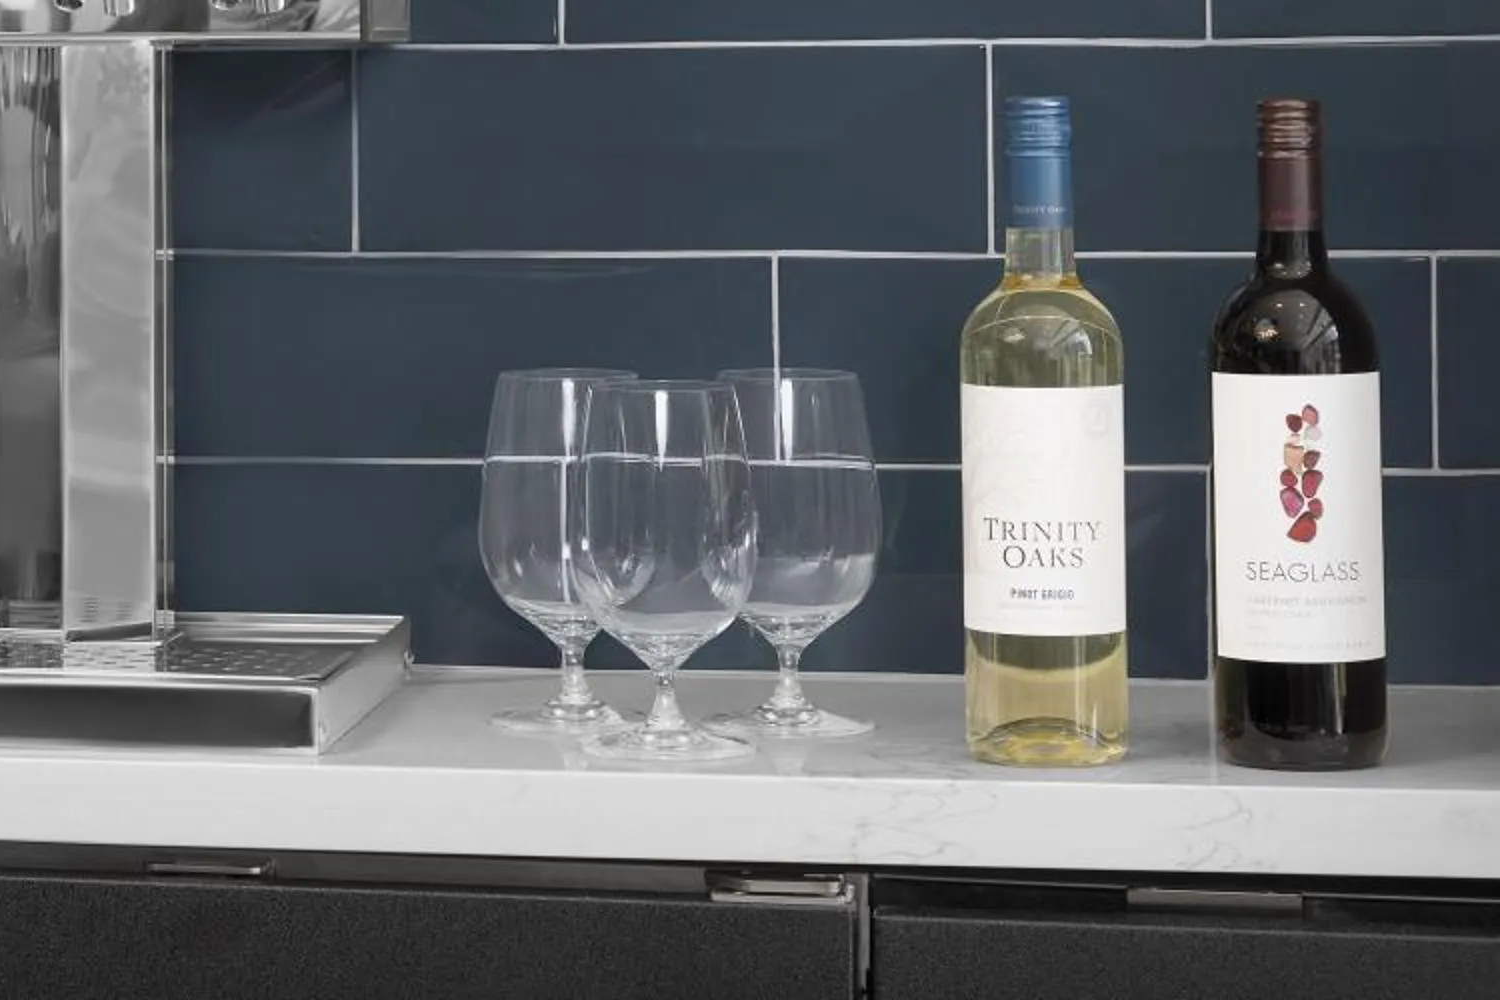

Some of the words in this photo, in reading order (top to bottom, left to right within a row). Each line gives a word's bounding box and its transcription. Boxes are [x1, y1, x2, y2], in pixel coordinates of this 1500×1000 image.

[983, 517, 1102, 542] TRINITY
[1002, 545, 1084, 569] OAKS
[1245, 561, 1361, 583] SEAGLASS
[1009, 587, 1038, 600] PINOT
[1041, 588, 1075, 600] GRIGIO
